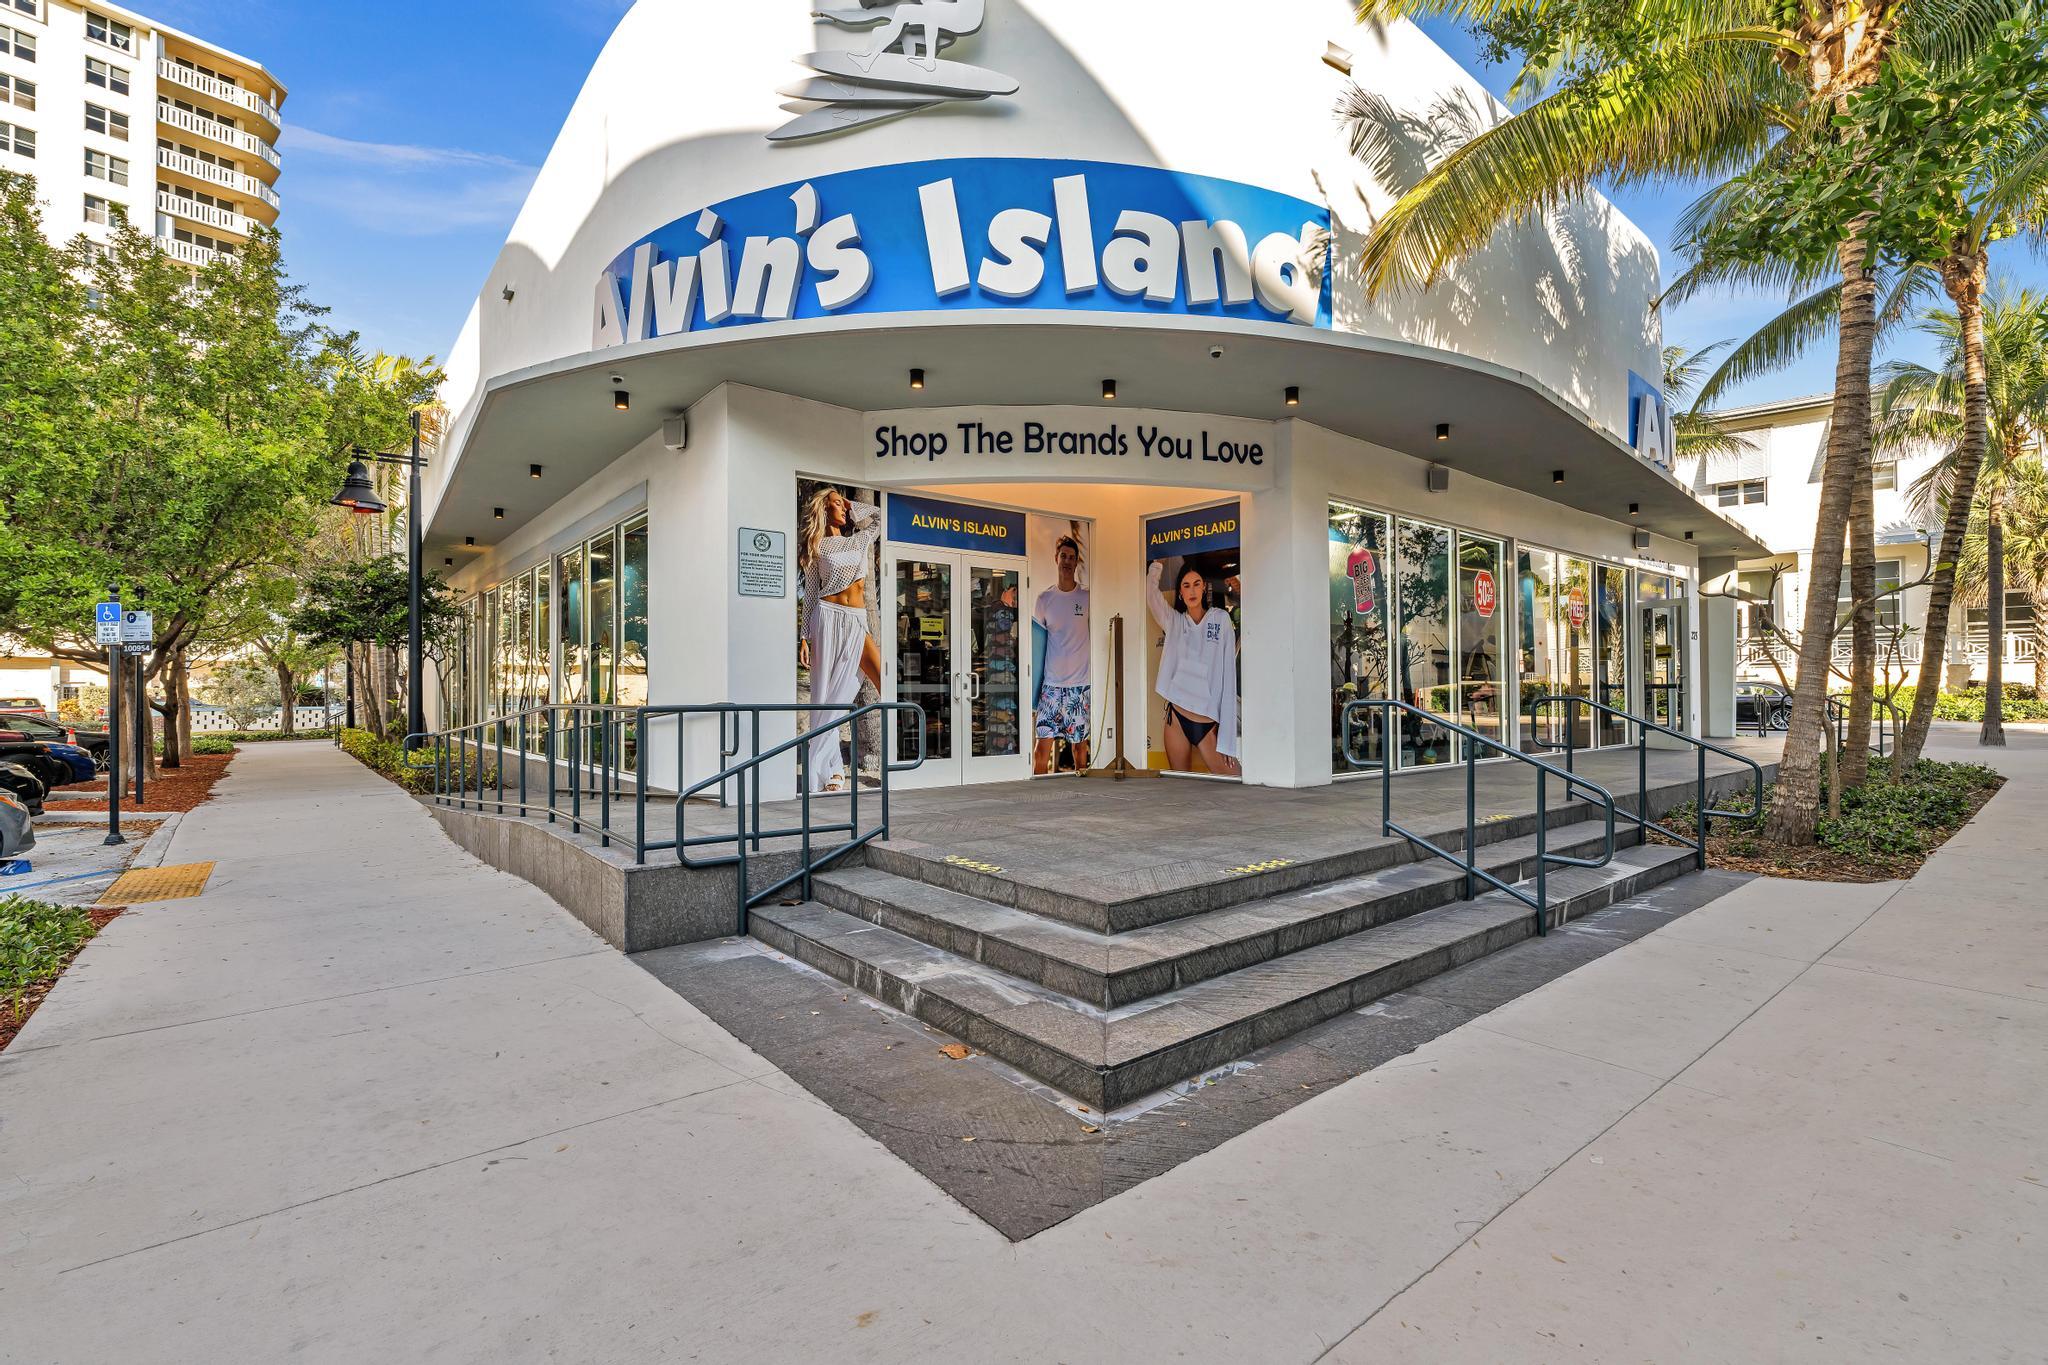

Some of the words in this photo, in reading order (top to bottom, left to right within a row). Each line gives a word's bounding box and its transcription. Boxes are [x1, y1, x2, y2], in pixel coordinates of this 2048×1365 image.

[593, 182, 873, 348] Alvin's
[917, 174, 1326, 327] Island
[875, 425, 948, 462] Shop
[957, 421, 1014, 454] The
[1023, 421, 1129, 456] Brands
[1136, 425, 1193, 460] You
[1201, 430, 1264, 466] Love
[911, 513, 961, 531] ALVIN'S
[963, 519, 1008, 539] ISLAND
[1150, 527, 1191, 546] ALVIN'S
[1193, 519, 1237, 539] ISLAND
[1353, 560, 1368, 577] BIG
[1569, 600, 1584, 617] FREE
